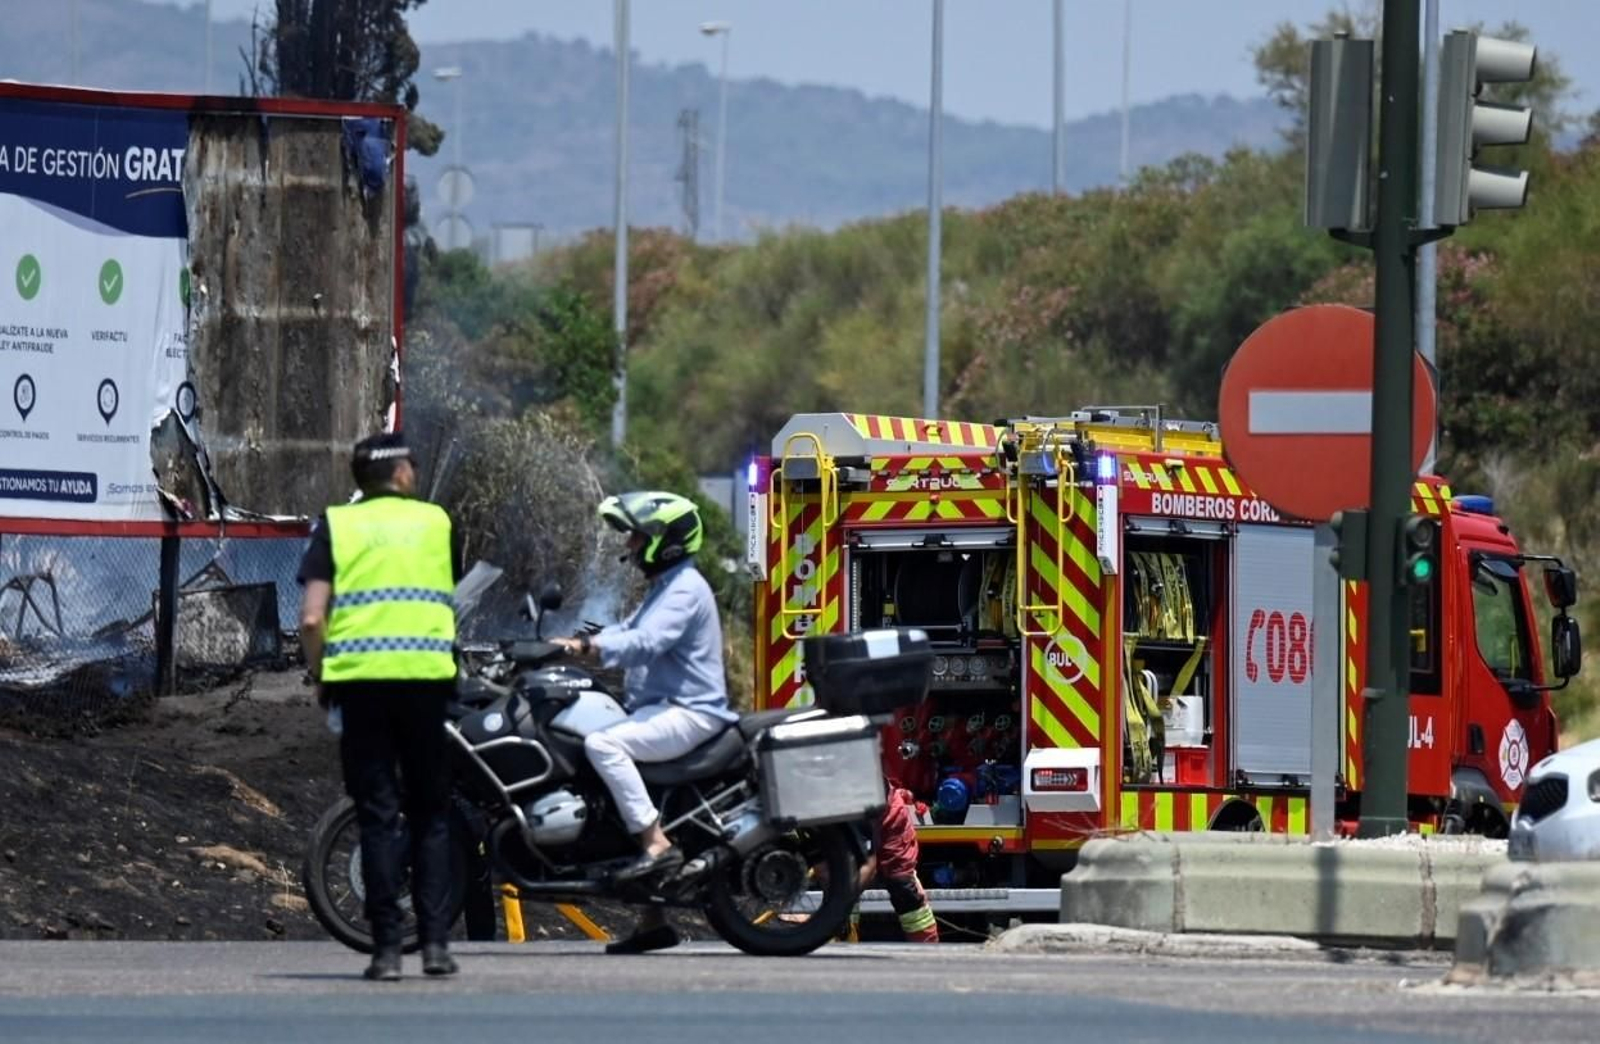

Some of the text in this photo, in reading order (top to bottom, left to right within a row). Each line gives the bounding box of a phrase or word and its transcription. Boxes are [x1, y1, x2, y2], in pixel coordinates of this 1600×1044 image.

[15, 146, 37, 173] DE
[42, 147, 119, 179] GESTIÓN
[36, 327, 44, 338] LA
[46, 327, 68, 339] NUEVA
[92, 331, 127, 343] VERIFACTU
[49, 479, 58, 492] TU
[60, 480, 92, 494] AYUDA
[1152, 492, 1235, 519] BOMBEROS
[1267, 611, 1314, 684] 08
